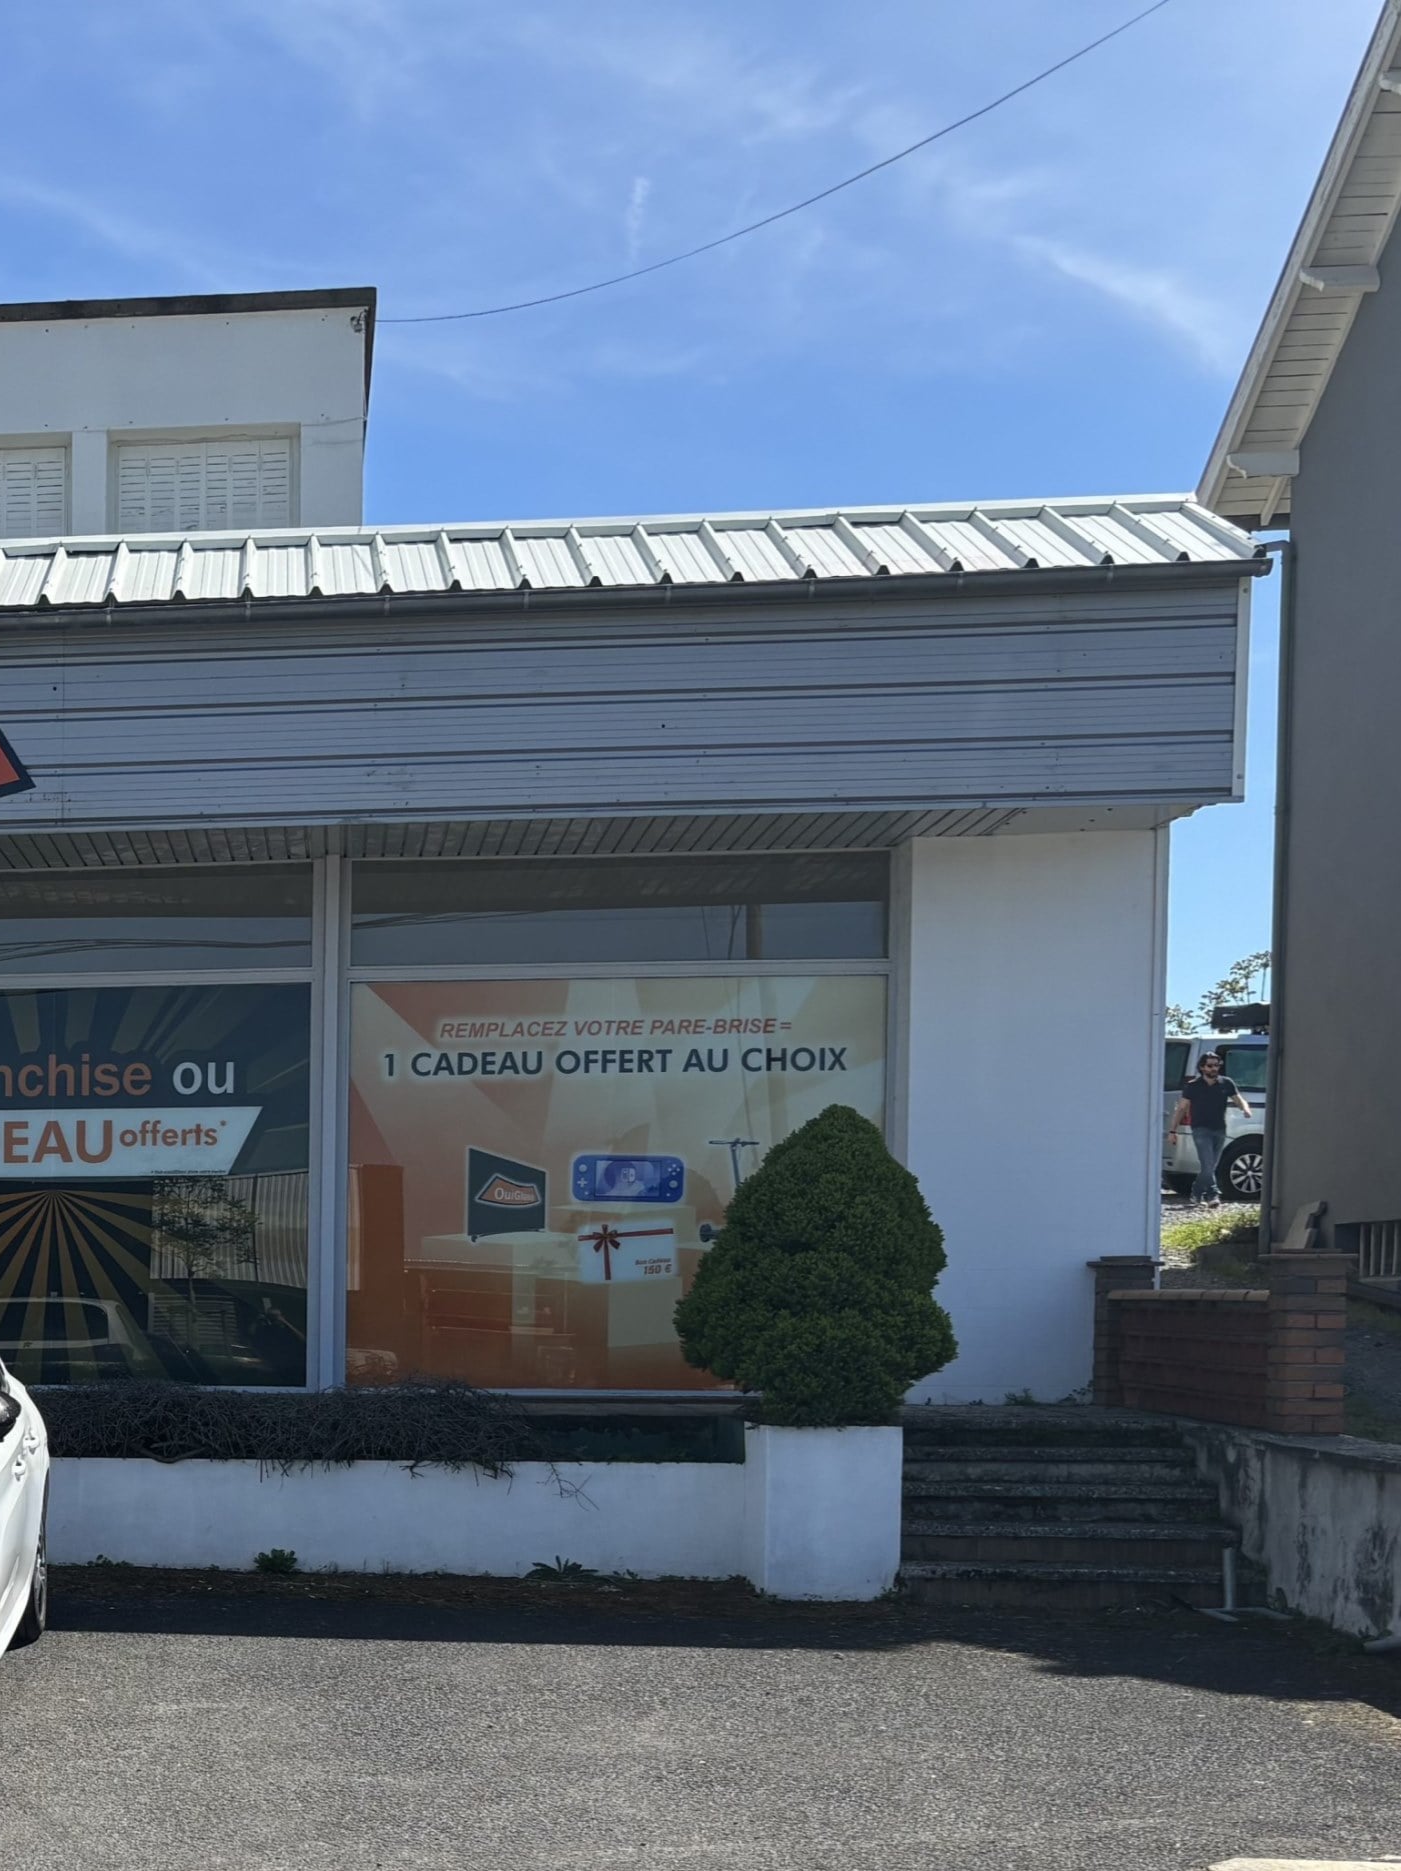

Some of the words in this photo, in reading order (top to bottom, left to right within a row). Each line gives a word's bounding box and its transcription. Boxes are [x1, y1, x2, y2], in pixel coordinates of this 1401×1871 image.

[440, 1020, 568, 1039] REMPLACEZ
[574, 1018, 645, 1037] VOTRE
[650, 1017, 775, 1036] PARE-BRISE
[383, 1053, 396, 1077] 1
[410, 1051, 544, 1077] CADEAU
[555, 1049, 673, 1075] OFFERT
[682, 1048, 729, 1073] AU
[741, 1047, 848, 1072] CHOIX
[172, 1061, 235, 1095] ou
